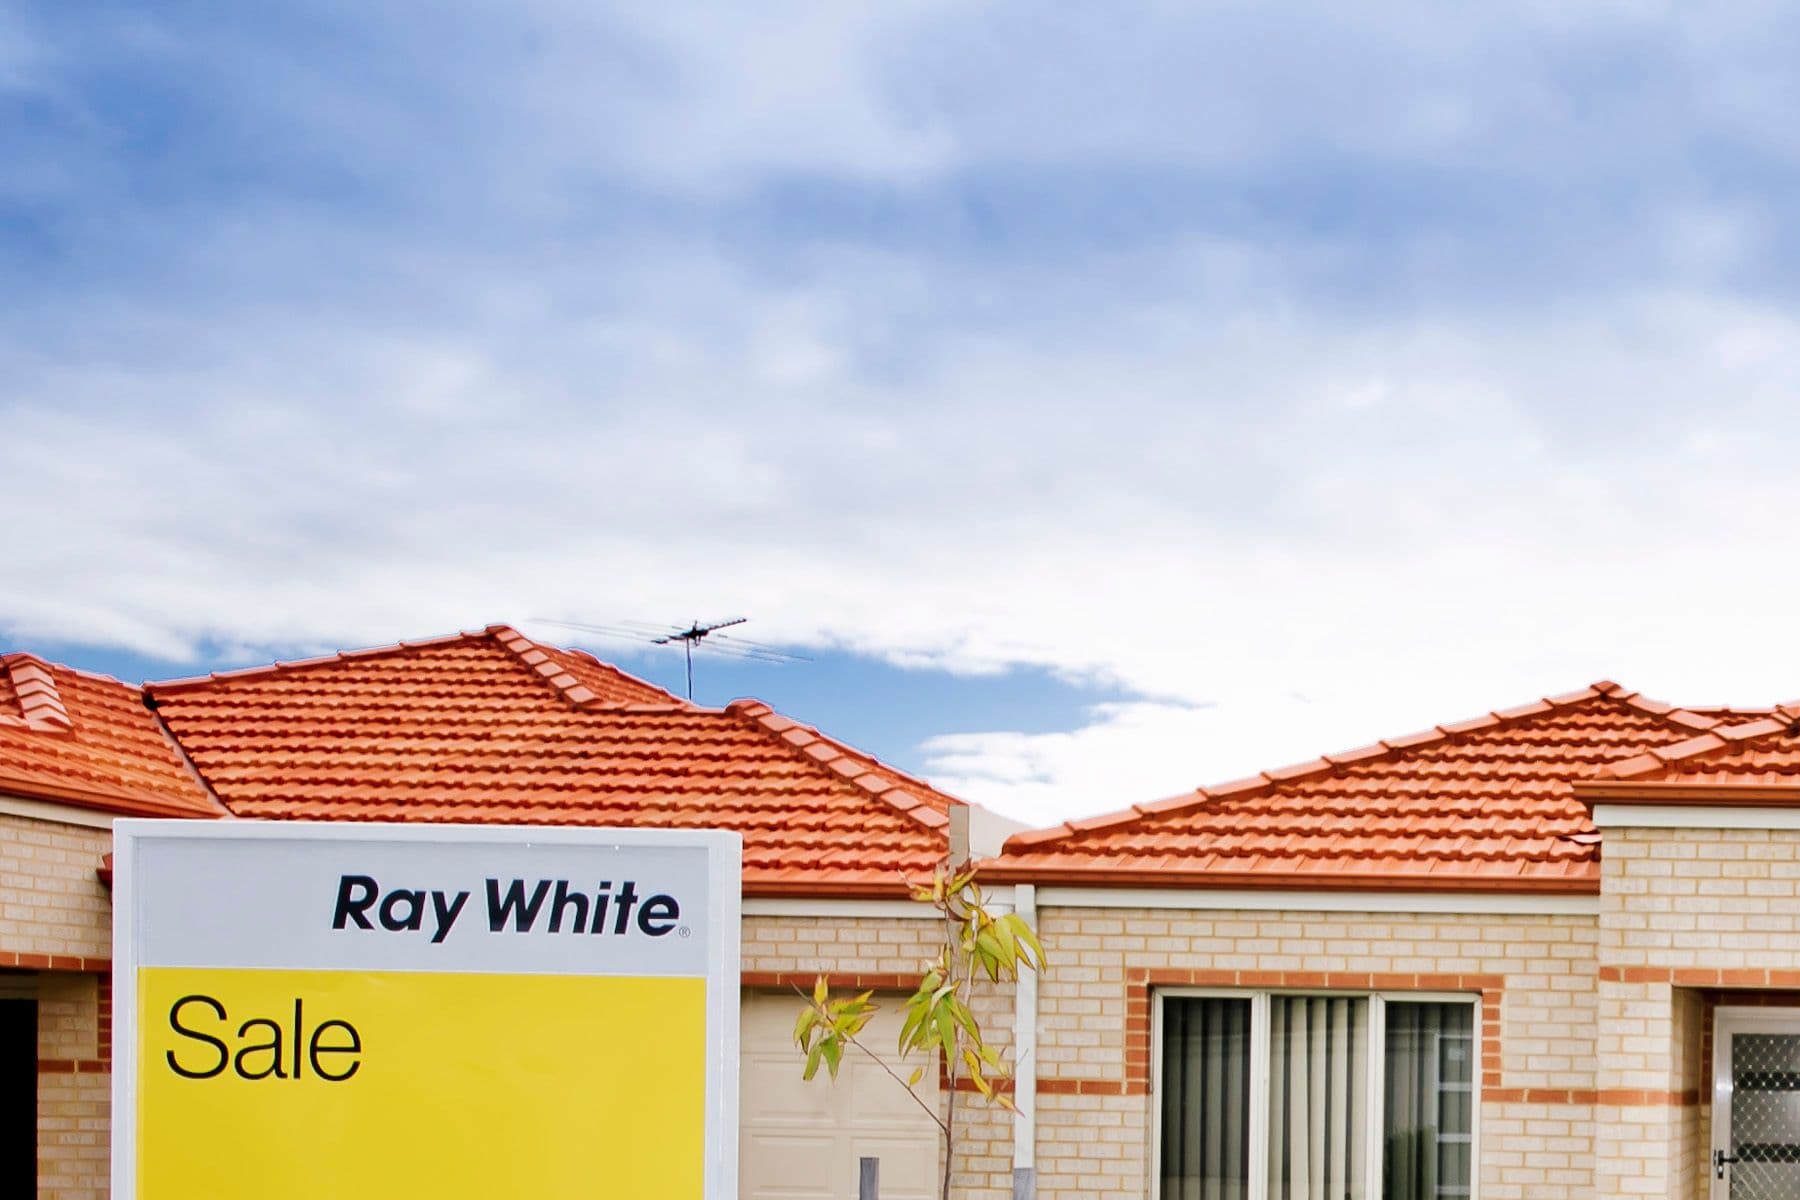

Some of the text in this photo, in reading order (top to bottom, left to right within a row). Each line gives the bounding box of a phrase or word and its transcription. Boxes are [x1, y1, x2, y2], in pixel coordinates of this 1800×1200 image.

[332, 875, 680, 944] Ray White
[166, 994, 362, 1082] Sale
